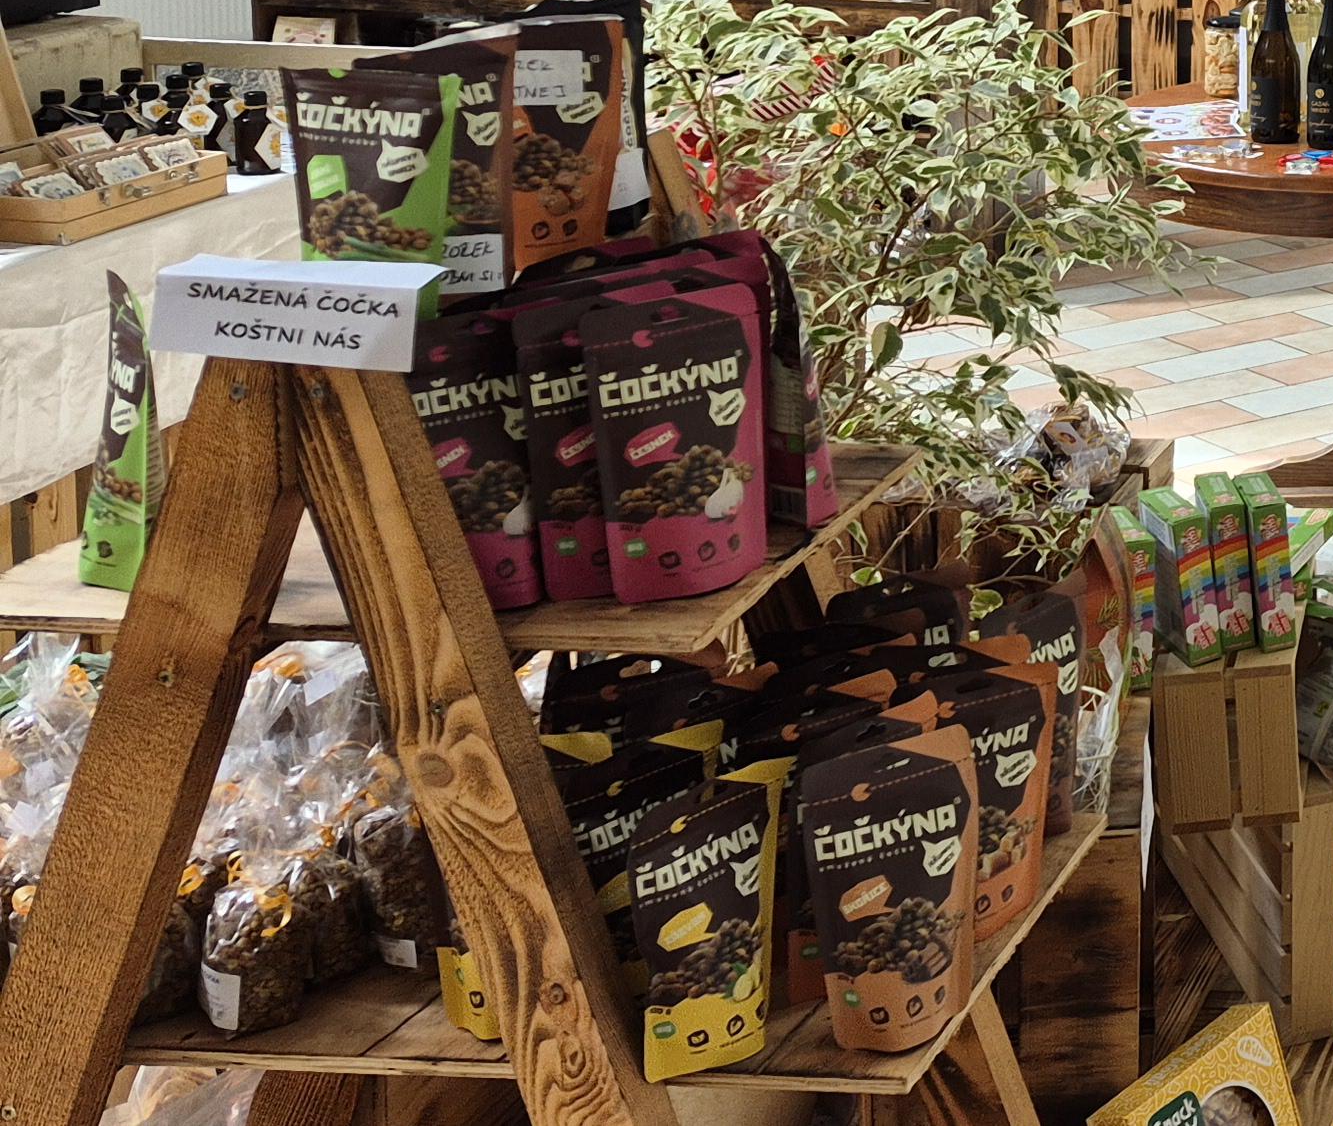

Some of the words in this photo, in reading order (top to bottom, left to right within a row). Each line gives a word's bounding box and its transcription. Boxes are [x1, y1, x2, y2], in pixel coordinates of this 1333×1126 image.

[296, 92, 422, 139] ČOČKÝNA
[187, 282, 308, 309] SMAŽENÁ
[316, 289, 399, 318] ČOČKA
[214, 317, 304, 346] KOŠTNI
[312, 327, 363, 351] NÁS
[598, 357, 739, 408] ČOČKÝNA
[814, 806, 958, 862] ČOČKÝNA
[635, 822, 761, 900] ČOČKÝNA
